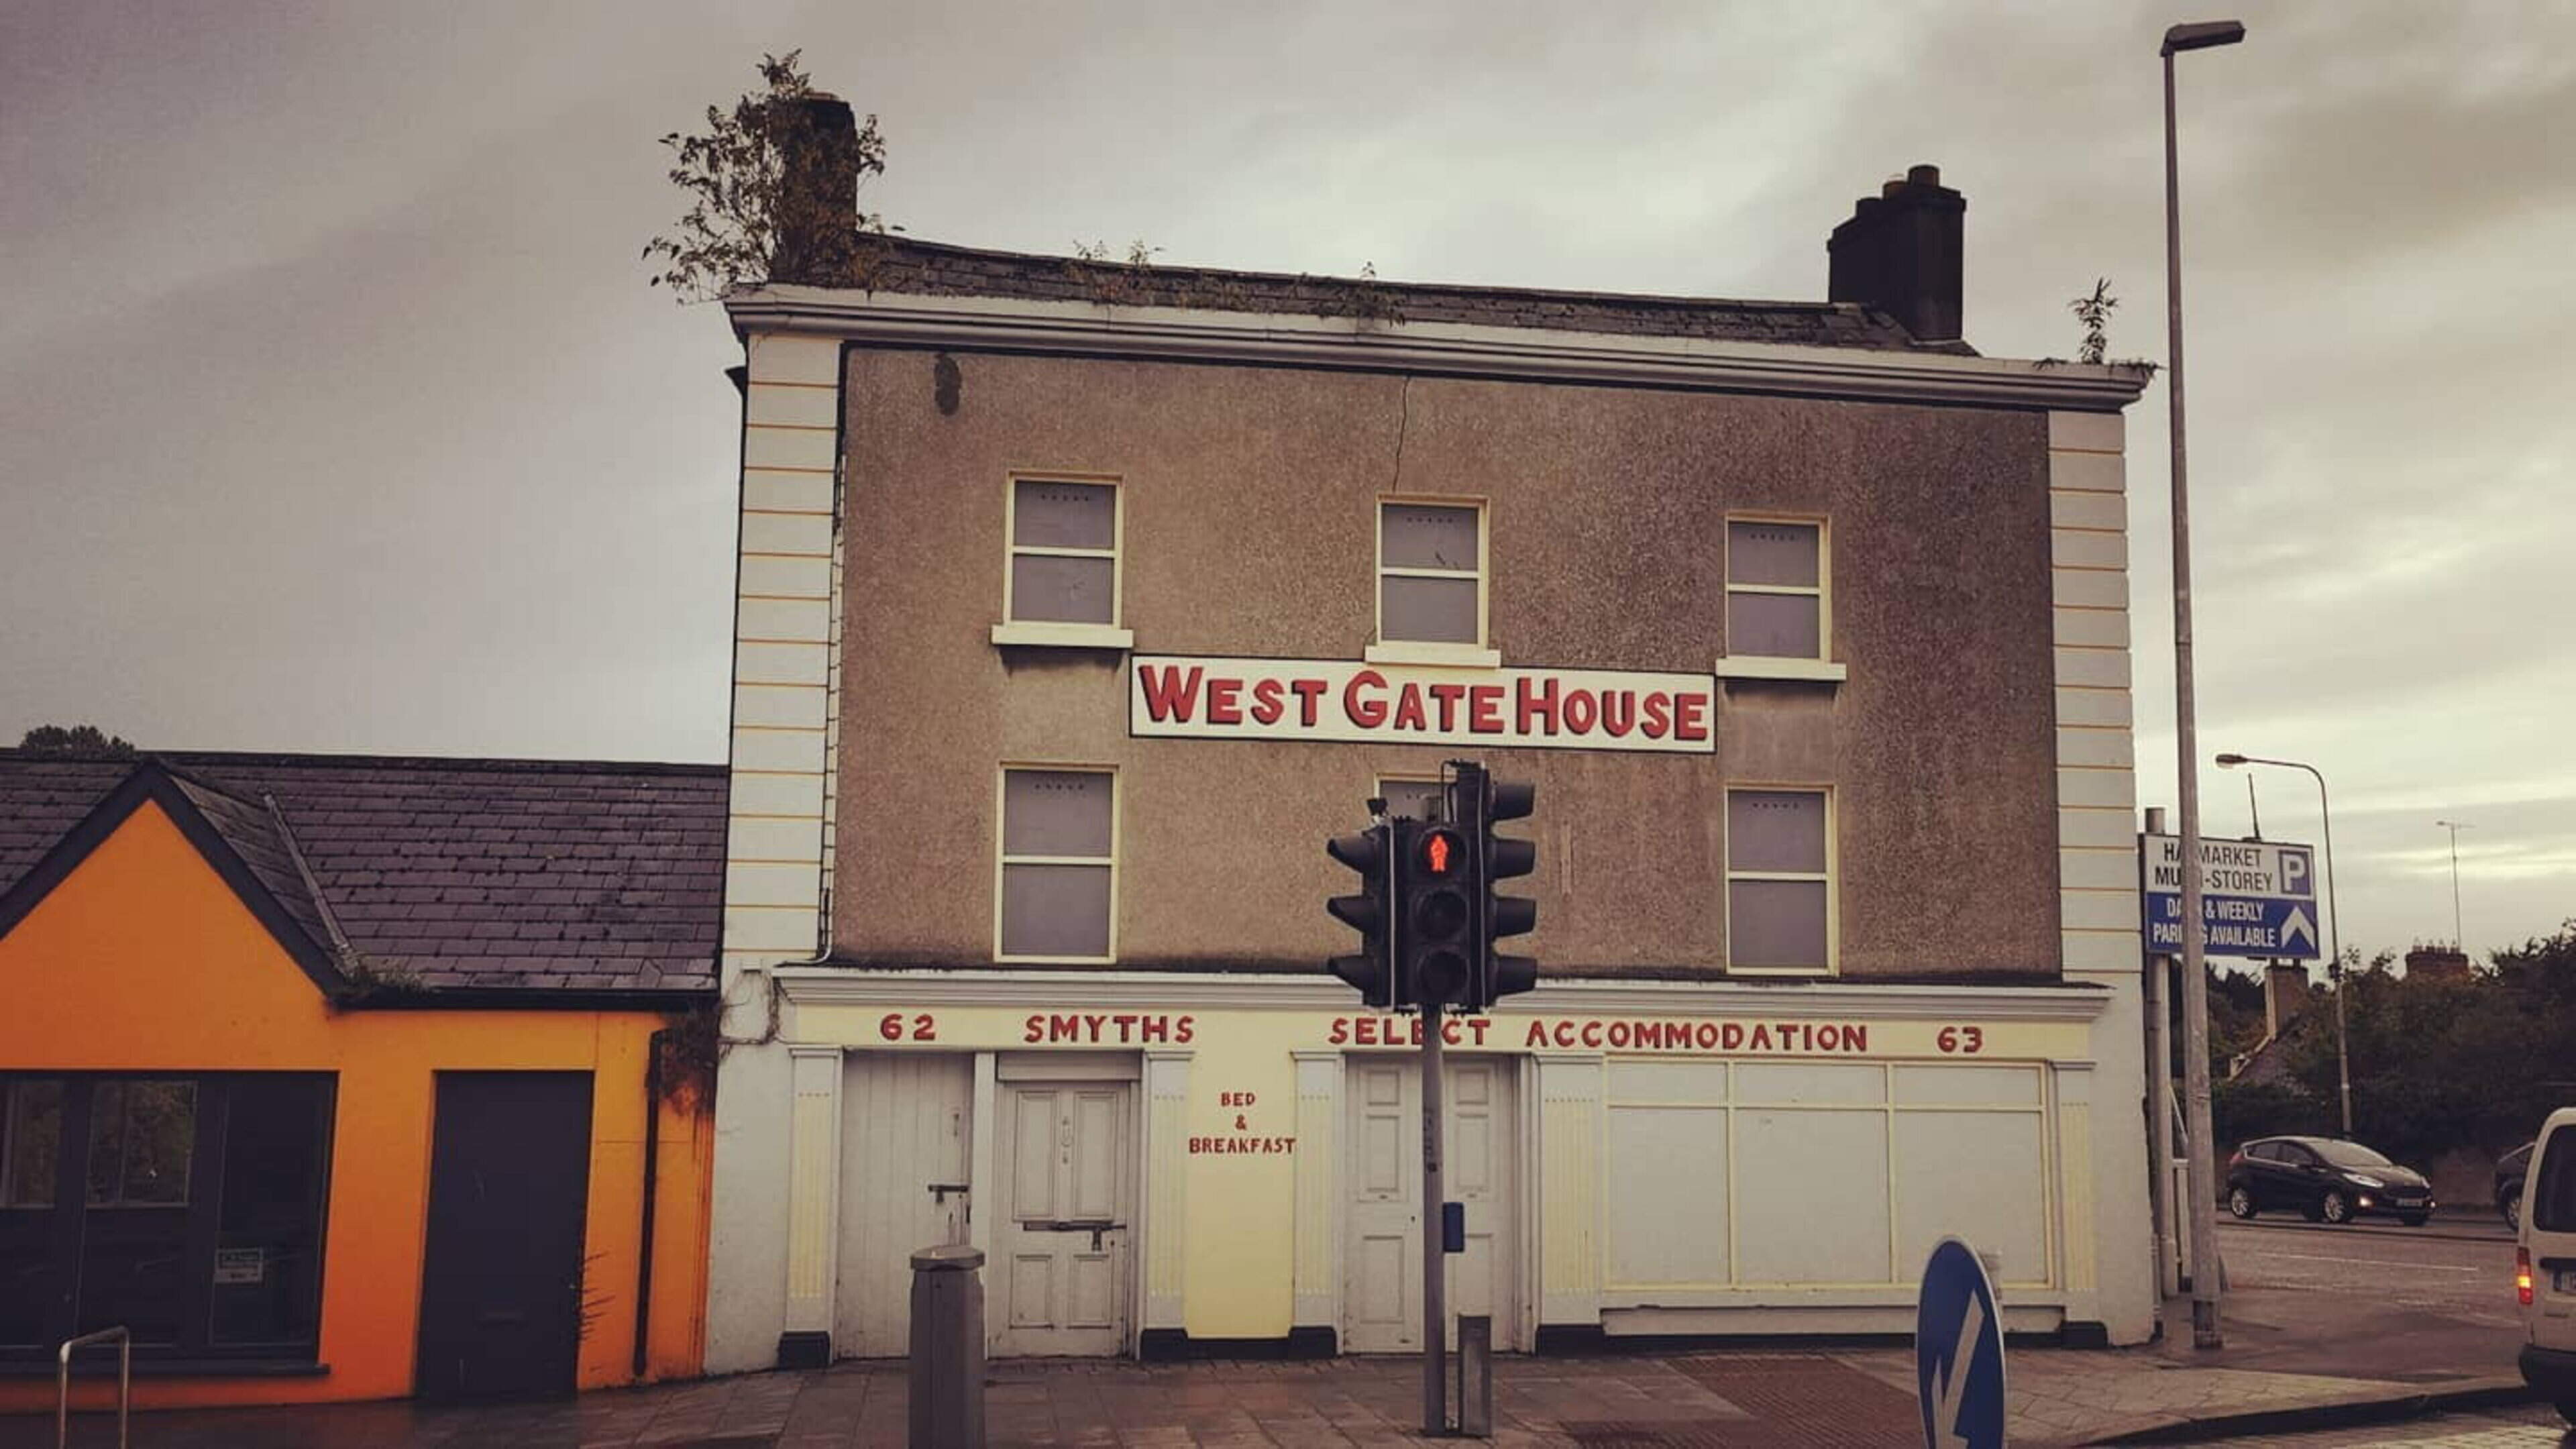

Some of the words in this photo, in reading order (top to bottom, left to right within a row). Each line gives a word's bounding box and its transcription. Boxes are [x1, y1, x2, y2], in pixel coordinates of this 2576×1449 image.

[1138, 665, 1329, 727] WEST
[2163, 843, 2261, 867] HAMARKET
[2155, 866, 2273, 891] MUI-STOREY
[2282, 853, 2306, 893] P
[2216, 901, 2264, 921] WEEKLY
[2153, 922, 2208, 945] PARG
[2210, 925, 2275, 947] AVAILABLE
[879, 1013, 936, 1040] 62
[1025, 1014, 1193, 1043] SMYTHS
[1329, 1017, 1491, 1045] SELECT
[1525, 1020, 1868, 1051] ACCOMMODATION
[1936, 1026, 1984, 1053] 63
[1220, 1092, 1255, 1106] BED
[1235, 1115, 1246, 1130] &
[1189, 1137, 1296, 1155] BREAKFAST
